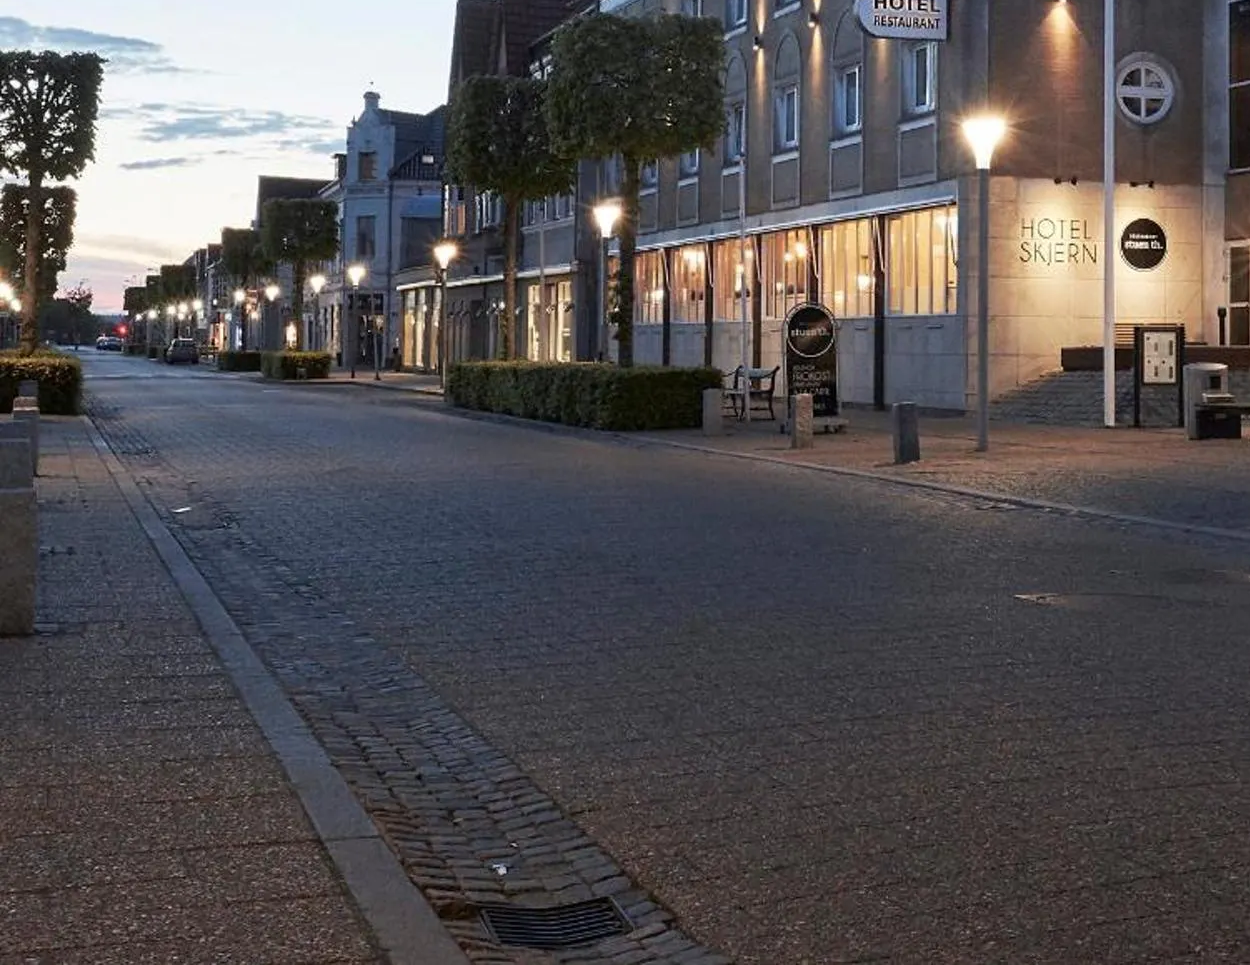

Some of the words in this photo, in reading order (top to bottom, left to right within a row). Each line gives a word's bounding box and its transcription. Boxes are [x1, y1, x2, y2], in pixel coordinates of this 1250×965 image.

[874, 15, 940, 30] RESTAURANT
[1021, 218, 1092, 239] HOTEL
[1019, 241, 1097, 265] SKJERN
